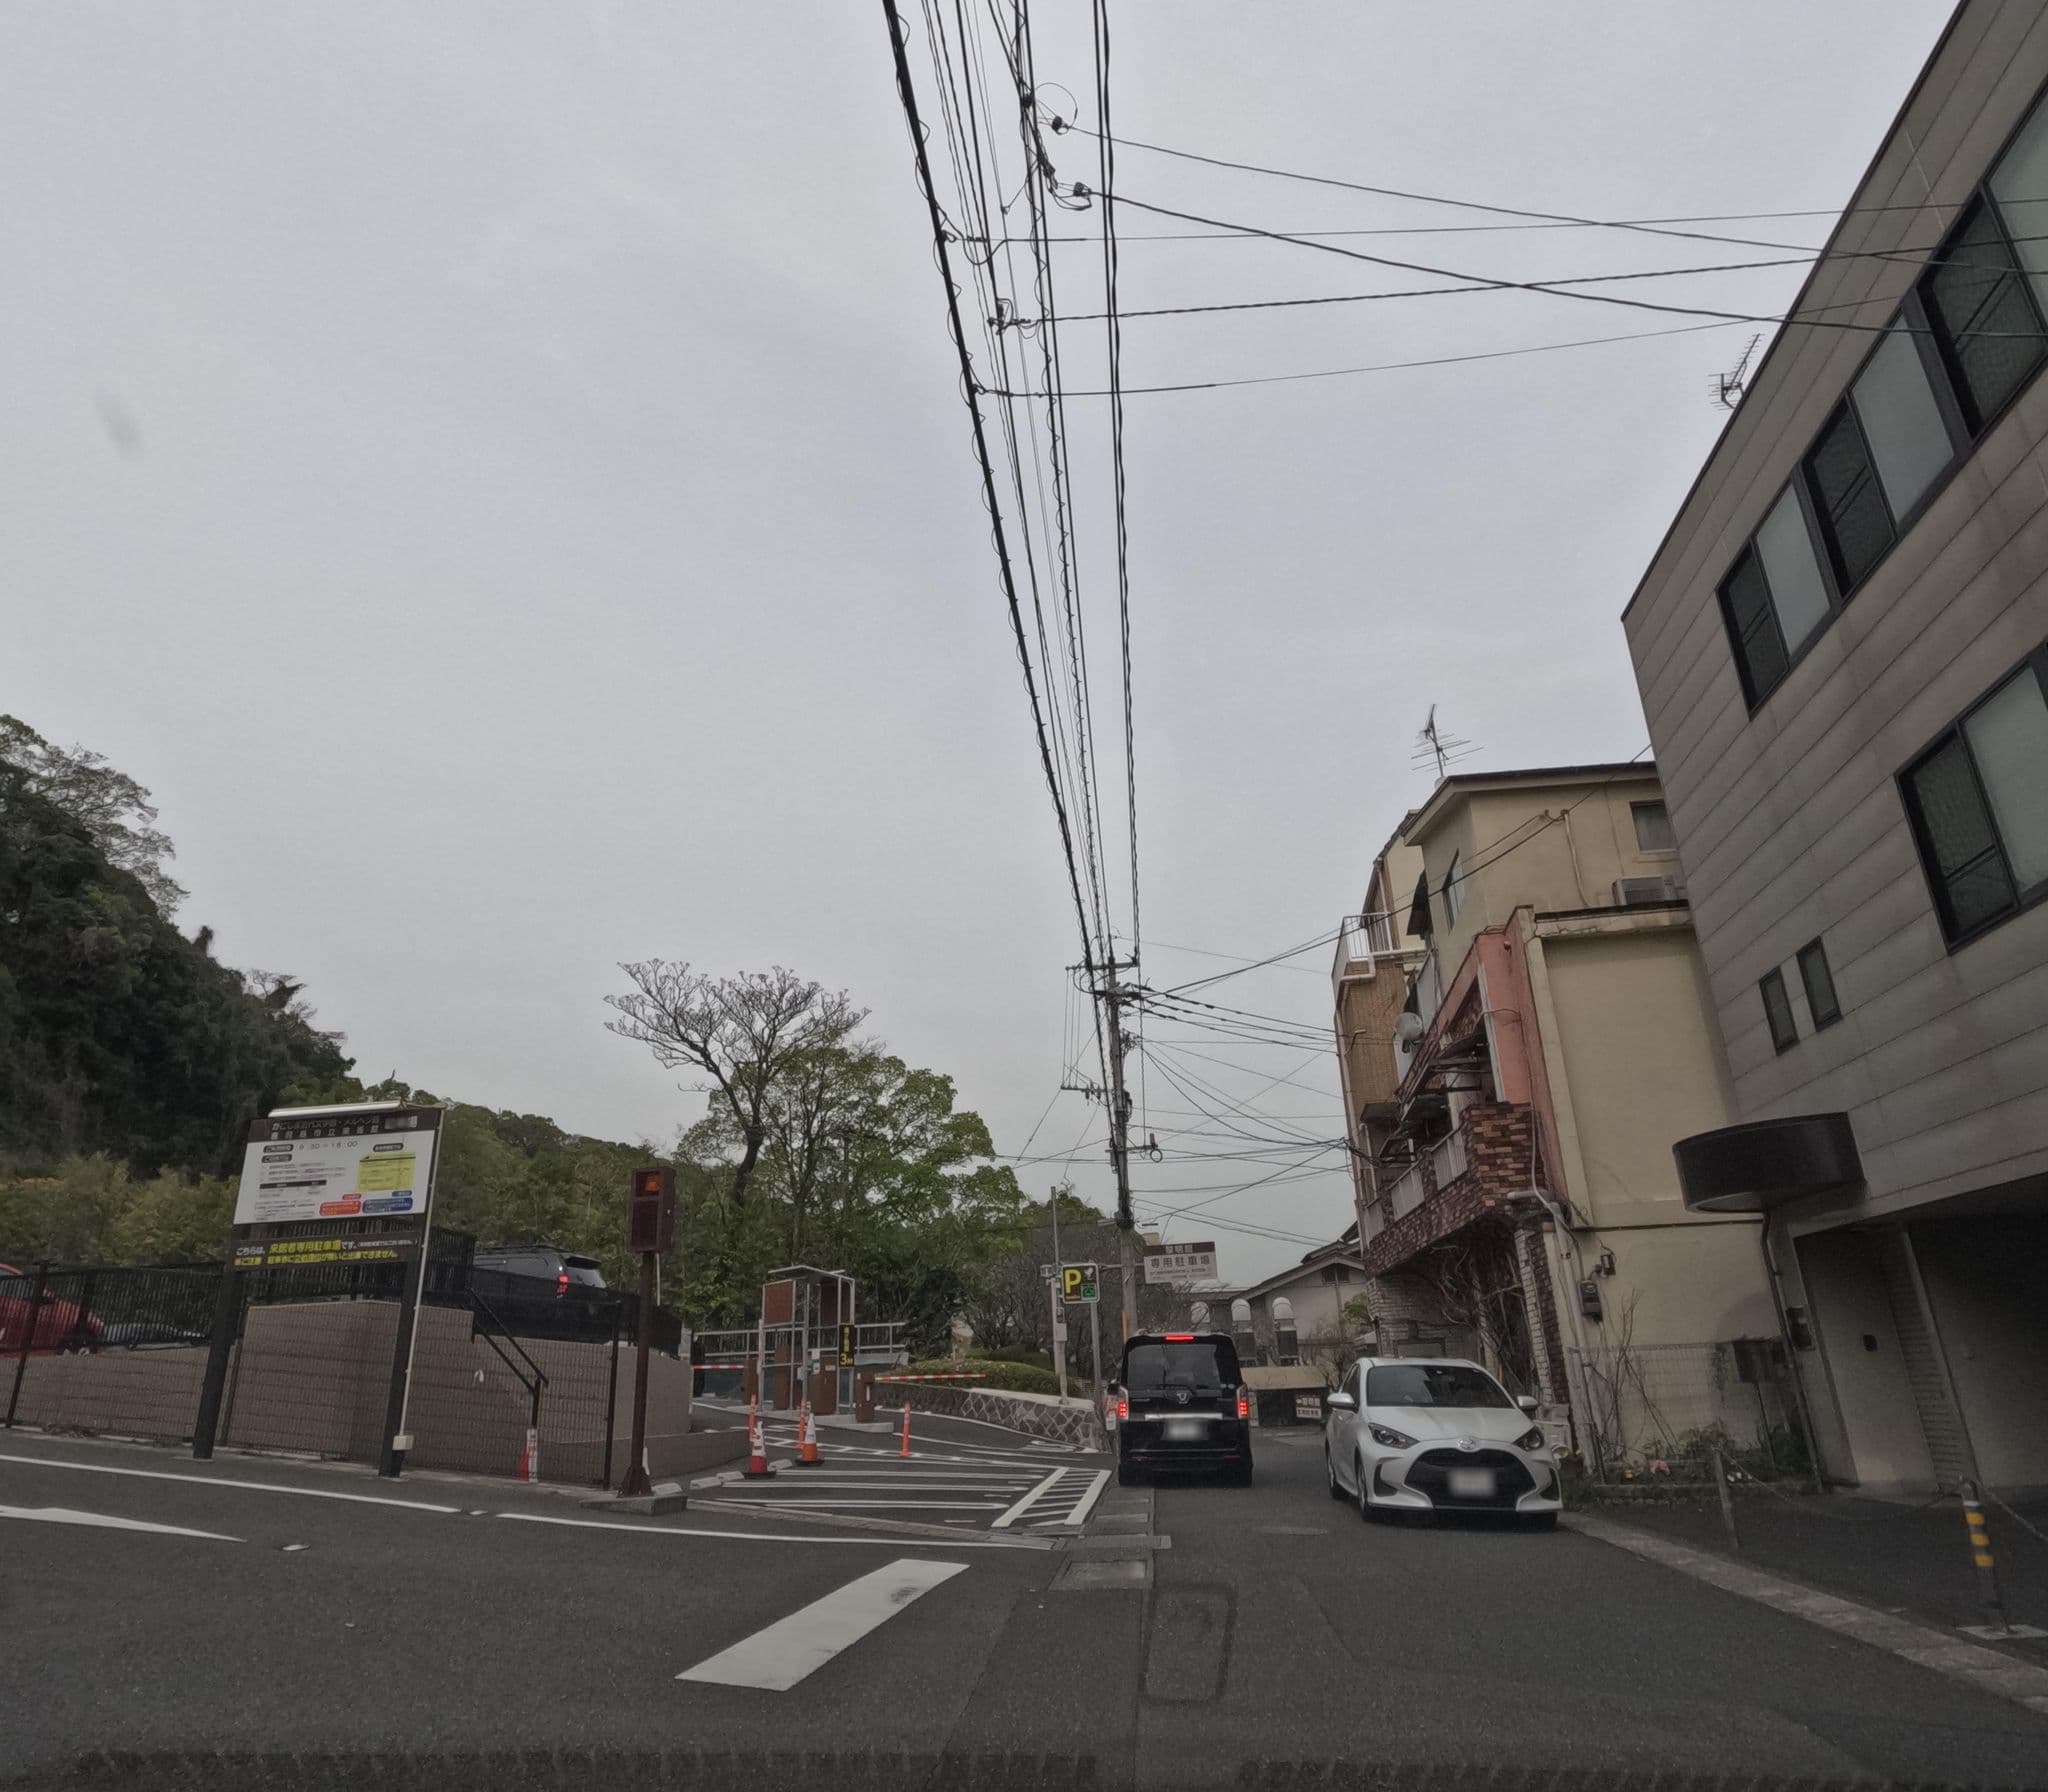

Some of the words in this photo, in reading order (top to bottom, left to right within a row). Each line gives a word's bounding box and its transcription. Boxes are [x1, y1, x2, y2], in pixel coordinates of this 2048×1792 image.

[1151, 1255, 1210, 1268] 専用駐車場
[1066, 1269, 1082, 1294] P
